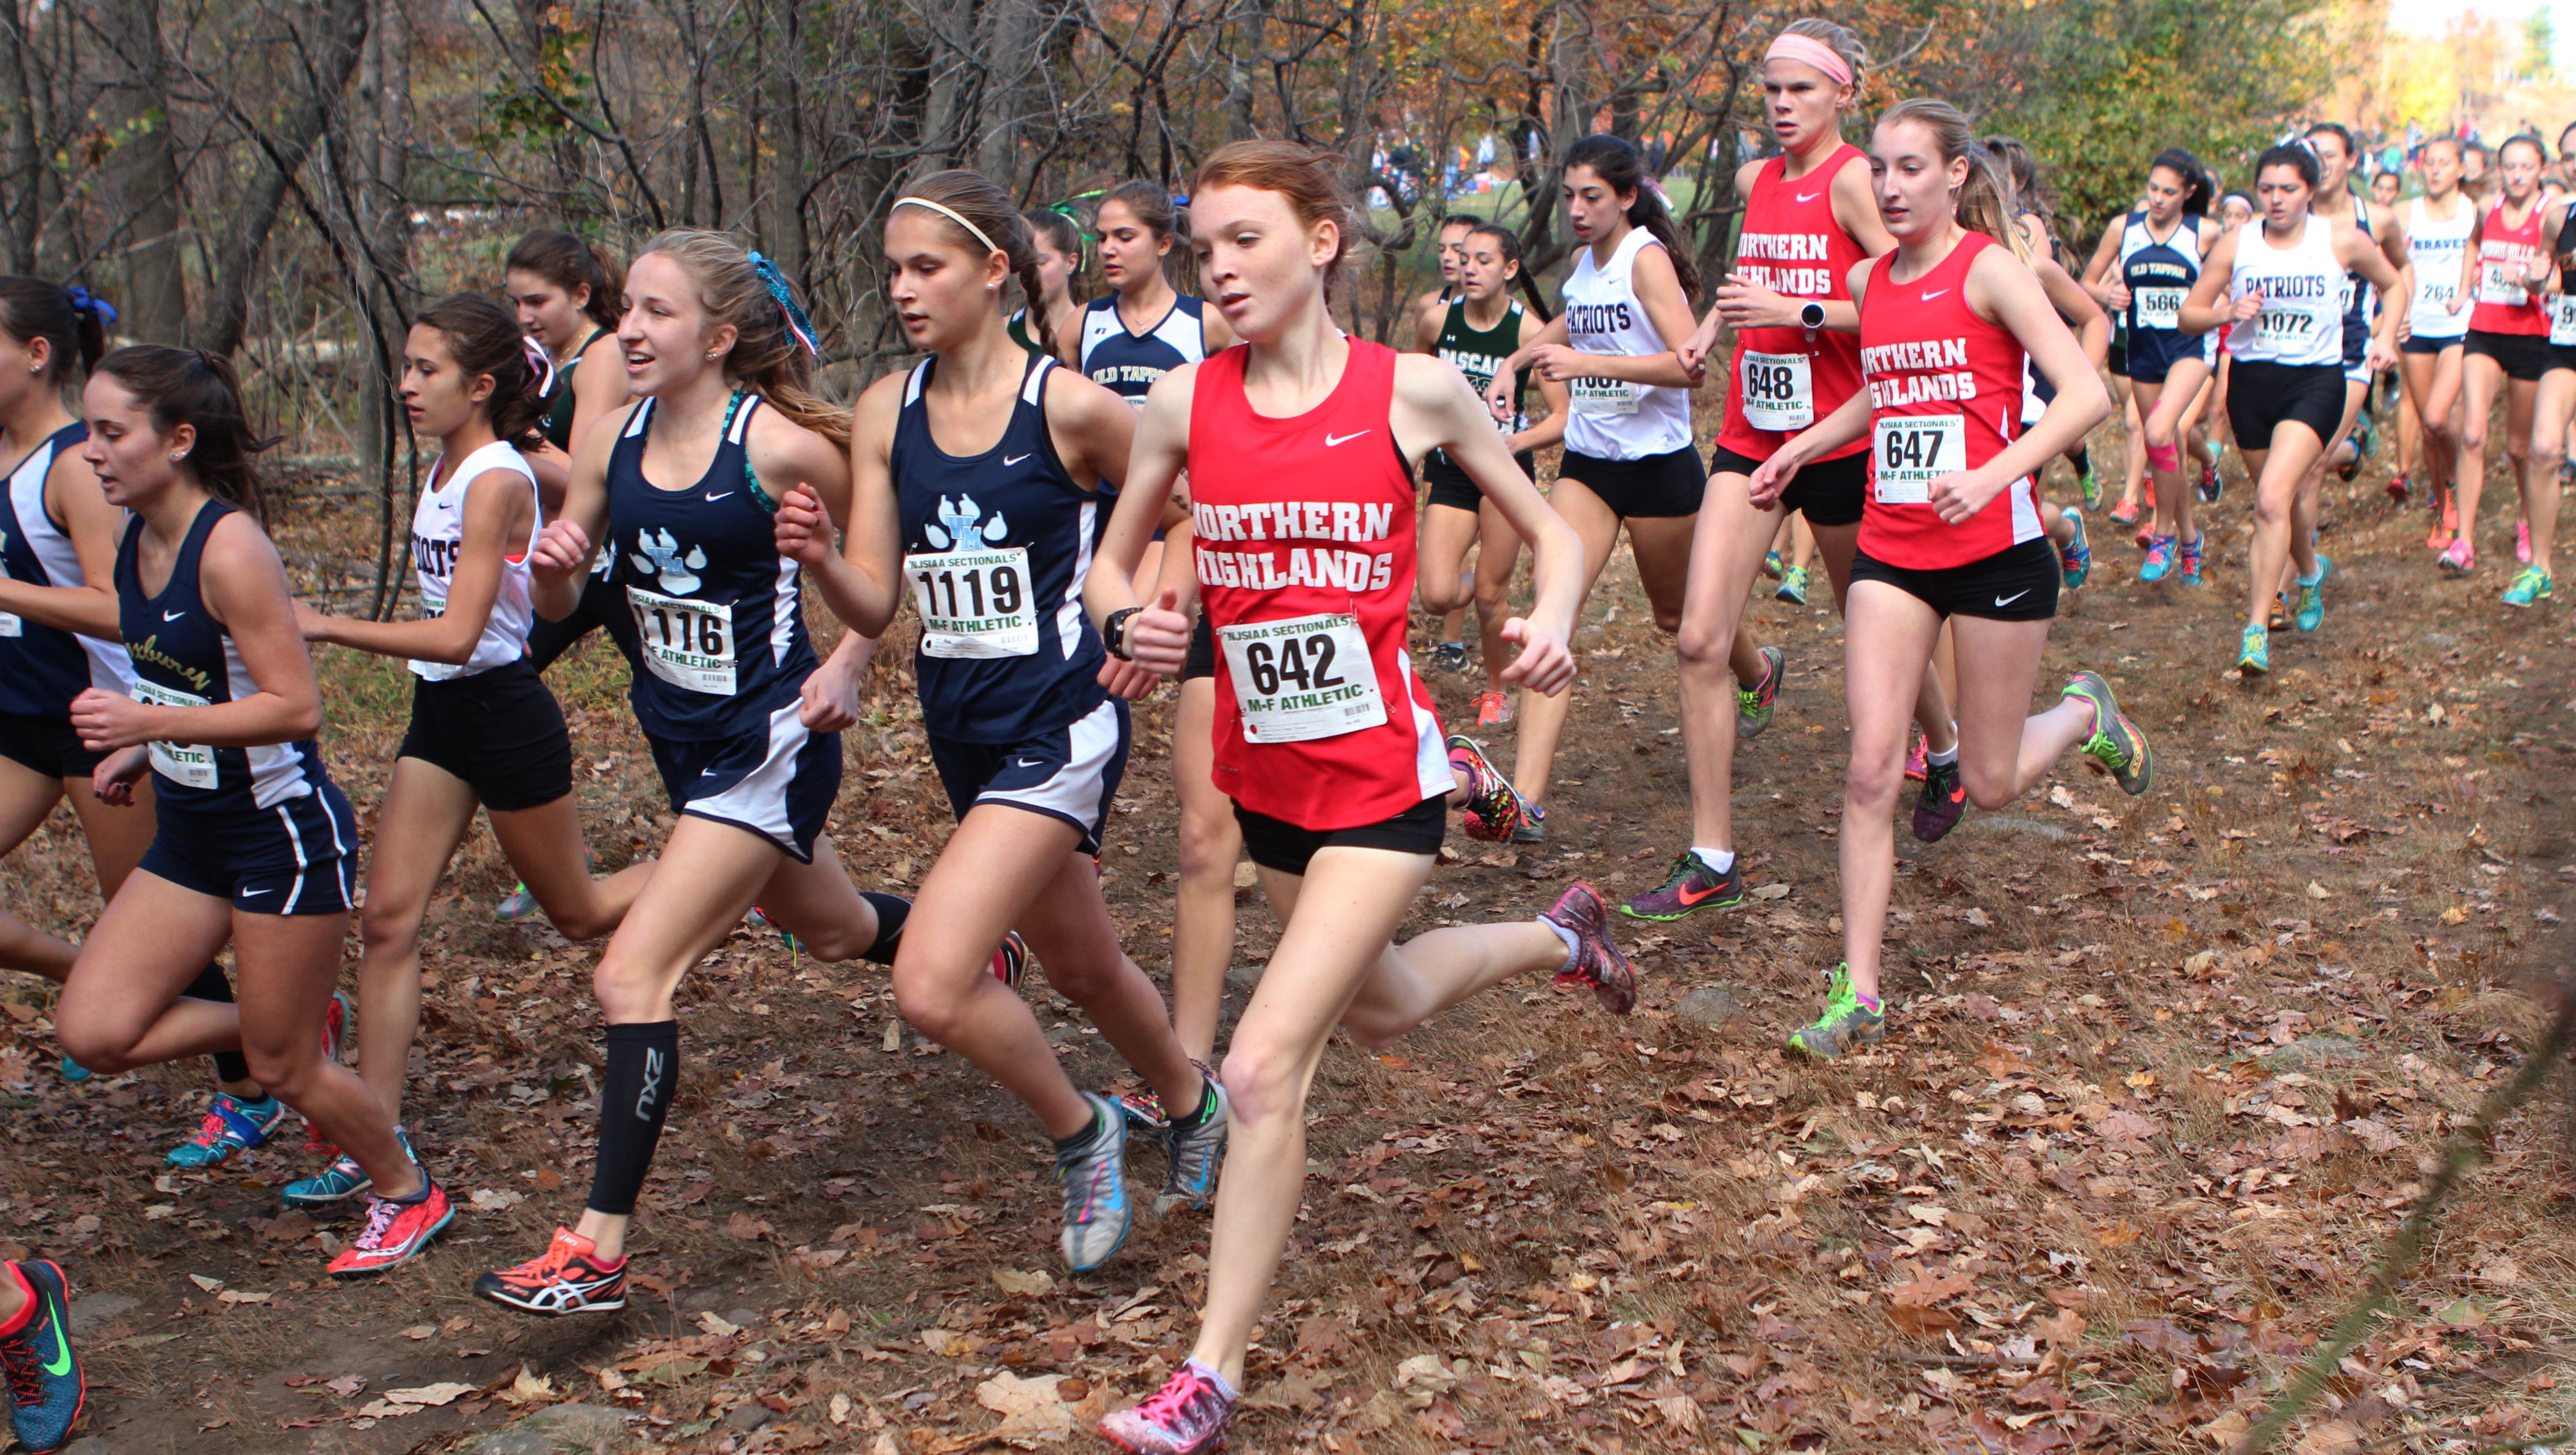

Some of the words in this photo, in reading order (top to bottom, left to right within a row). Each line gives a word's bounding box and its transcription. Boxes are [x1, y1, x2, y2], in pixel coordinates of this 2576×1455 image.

[1738, 232, 1828, 260] ORTHERN
[2131, 263, 2147, 277] OLD
[2149, 263, 2186, 279] TAPPAN
[2246, 275, 2325, 298] PATRIOTS
[2425, 284, 2454, 301] 264
[2147, 294, 2179, 310] 566
[1567, 303, 1631, 334] PATRIOTS
[2260, 312, 2313, 333] 1072
[1860, 338, 1967, 375] ORTHERN
[1093, 367, 1118, 384] OLD
[1120, 366, 1166, 383] TAPP
[1748, 363, 1793, 400] 648
[1869, 372, 1976, 409] GHLANDS
[1756, 401, 1803, 410] ATHLETIC
[1887, 430, 1943, 468] 647
[1880, 471, 1896, 480] M-F
[1900, 470, 1954, 480] ATHLET
[1194, 500, 1393, 542] NORTHERN
[910, 559, 945, 569] NJSIAA
[948, 553, 1017, 567] SECTIONALS
[1197, 545, 1392, 592] HIGHLANDS
[917, 566, 1022, 617] 1119
[658, 601, 721, 614] SECTIONALS
[633, 604, 723, 656] 1116
[928, 618, 948, 631] M-F
[952, 615, 1022, 632] ATHLETIC
[1227, 629, 1269, 641] NJSIAA
[1273, 616, 1349, 636] SECTIONALS
[660, 649, 723, 669] ATHLETIC
[1246, 634, 1345, 695] 642
[1247, 698, 1275, 712] M-F
[1281, 684, 1364, 710] ATHLETIC
[169, 748, 205, 764] LETIC
